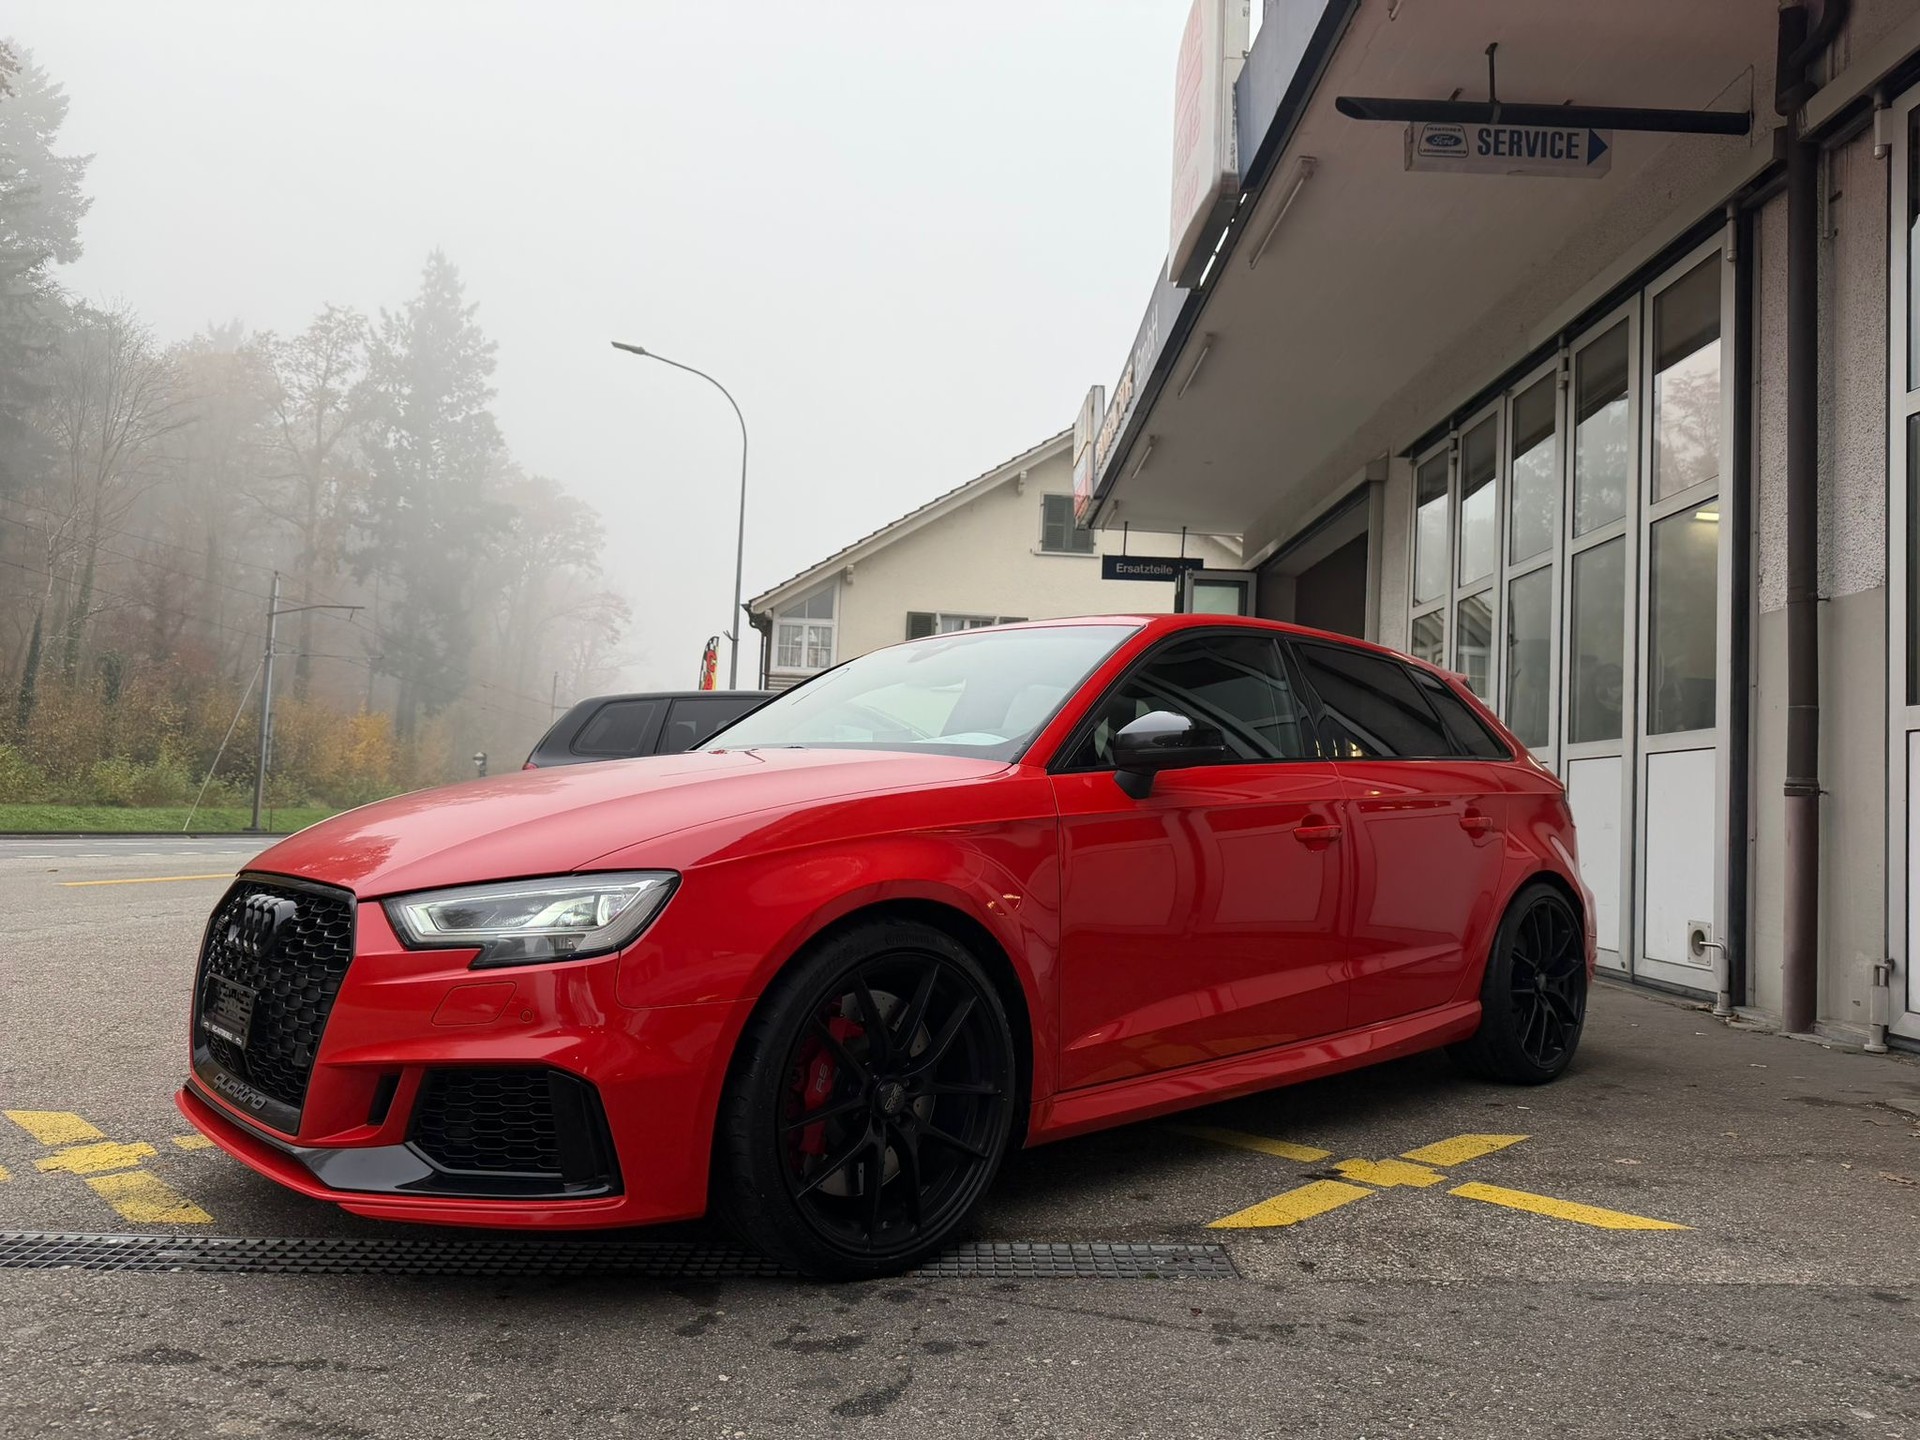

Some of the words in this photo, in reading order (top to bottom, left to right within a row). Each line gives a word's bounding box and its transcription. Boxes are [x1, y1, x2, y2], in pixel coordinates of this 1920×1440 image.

[1478, 128, 1579, 159] SERVICE
[1116, 563, 1173, 575] Ersatzteile
[214, 1073, 266, 1109] quattro
[816, 1063, 828, 1092] RS
